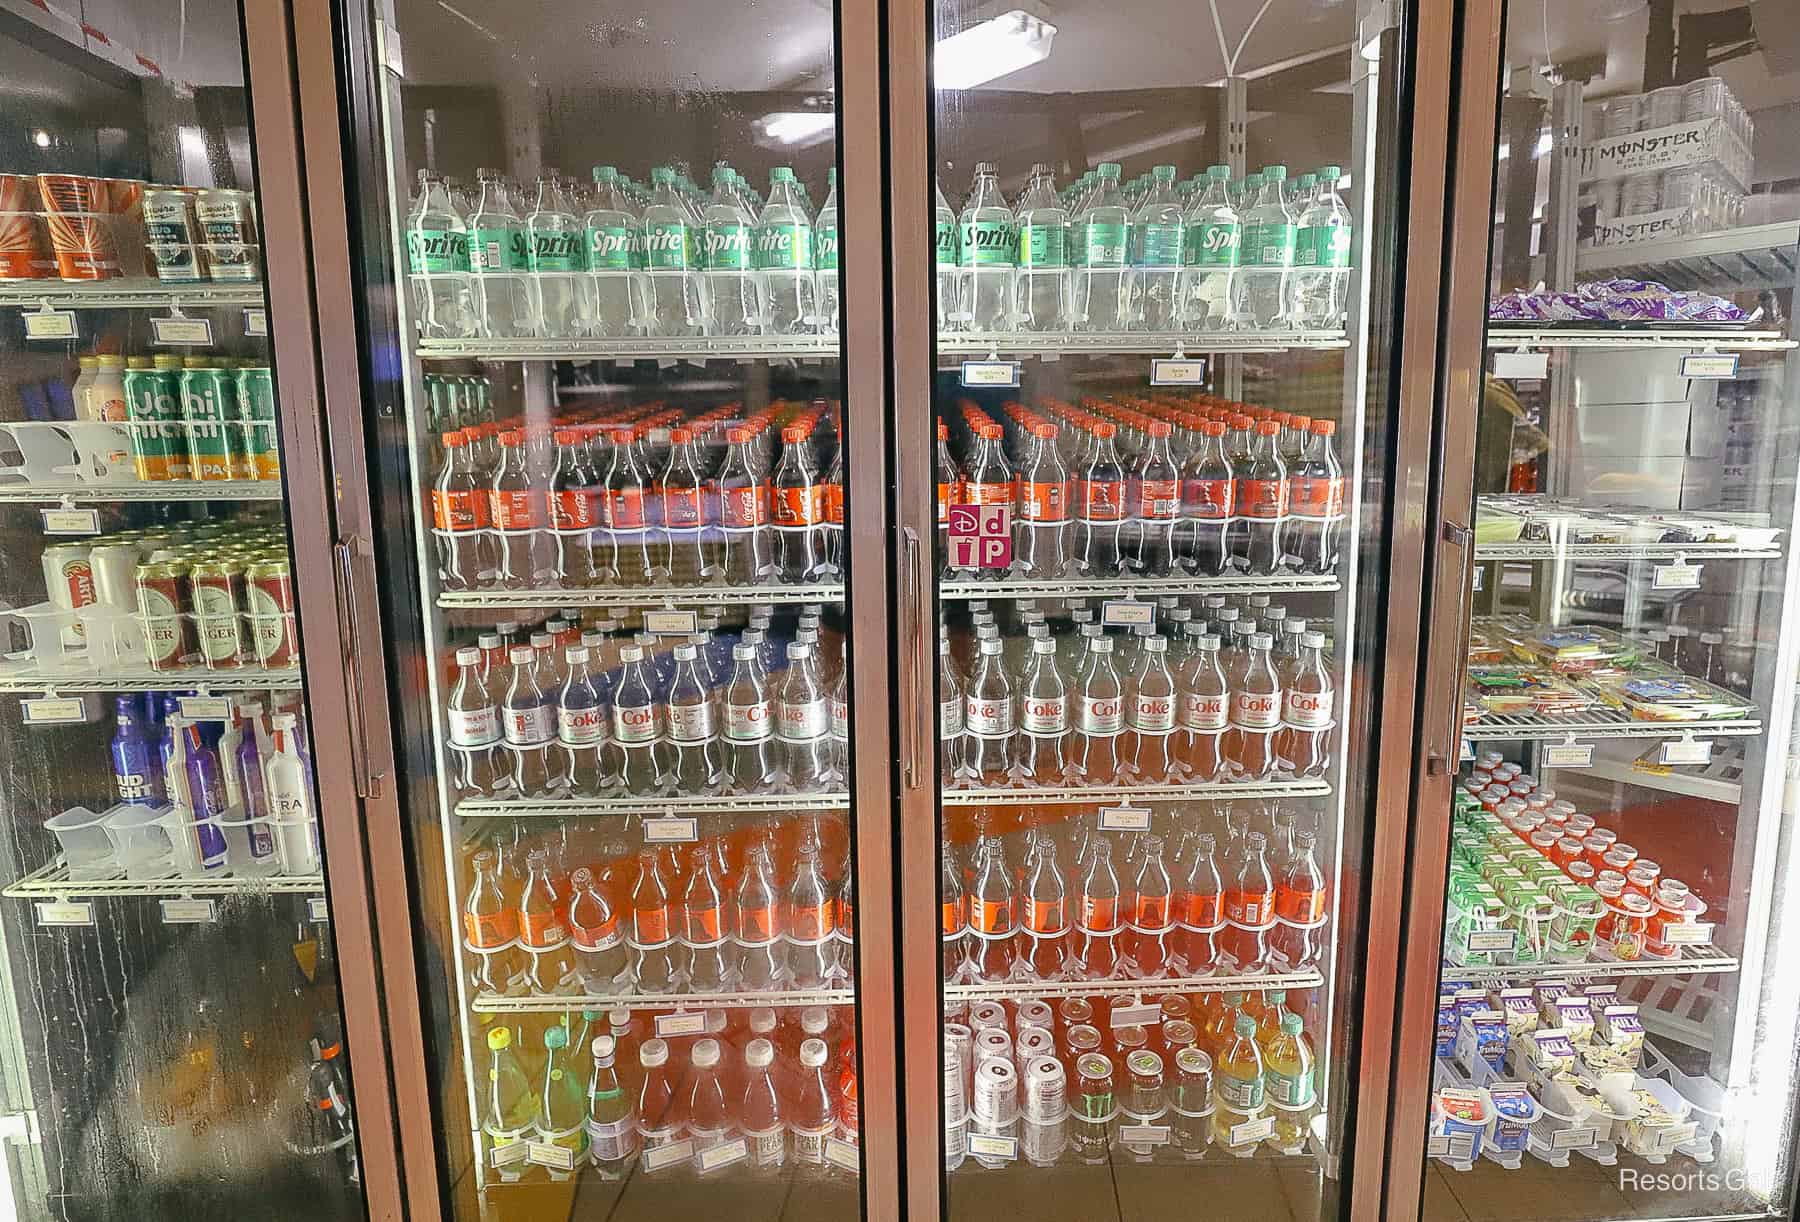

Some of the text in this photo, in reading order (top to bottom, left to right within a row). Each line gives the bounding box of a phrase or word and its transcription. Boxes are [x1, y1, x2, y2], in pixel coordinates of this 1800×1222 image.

[1203, 227, 1241, 252] Spri
[967, 702, 995, 717] oke
[1505, 999, 1536, 1012] MILK
[1560, 1006, 1592, 1021] MILK
[1611, 1016, 1642, 1031] MILK
[1540, 1040, 1569, 1054] MILK
